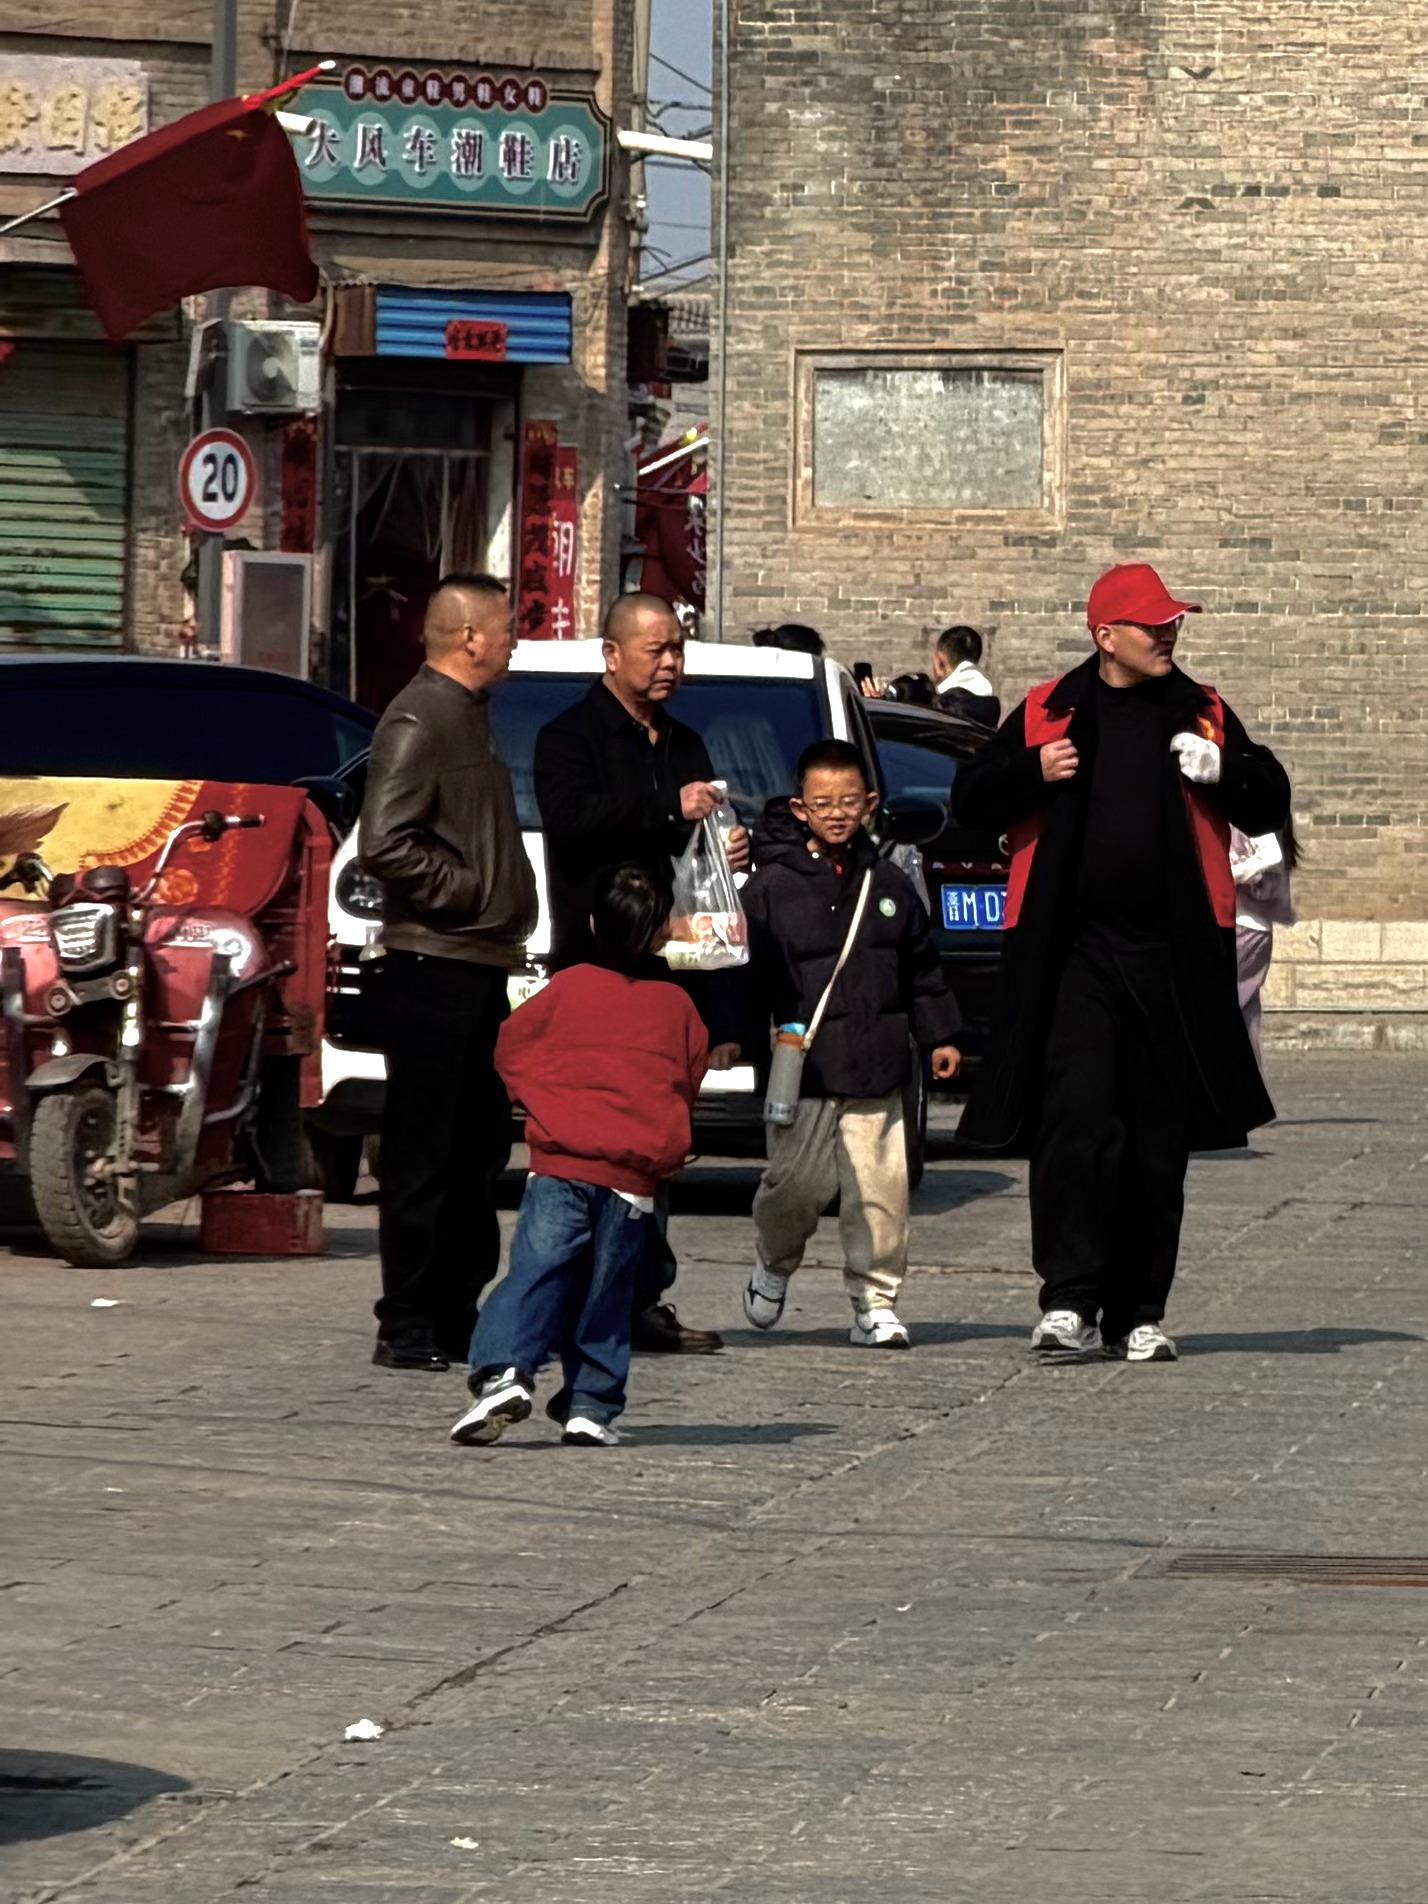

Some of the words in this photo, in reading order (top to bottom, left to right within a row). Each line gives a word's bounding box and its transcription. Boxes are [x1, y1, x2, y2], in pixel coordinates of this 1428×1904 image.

[305, 119, 584, 184] 大风车潮鞋店
[202, 453, 238, 503] 20
